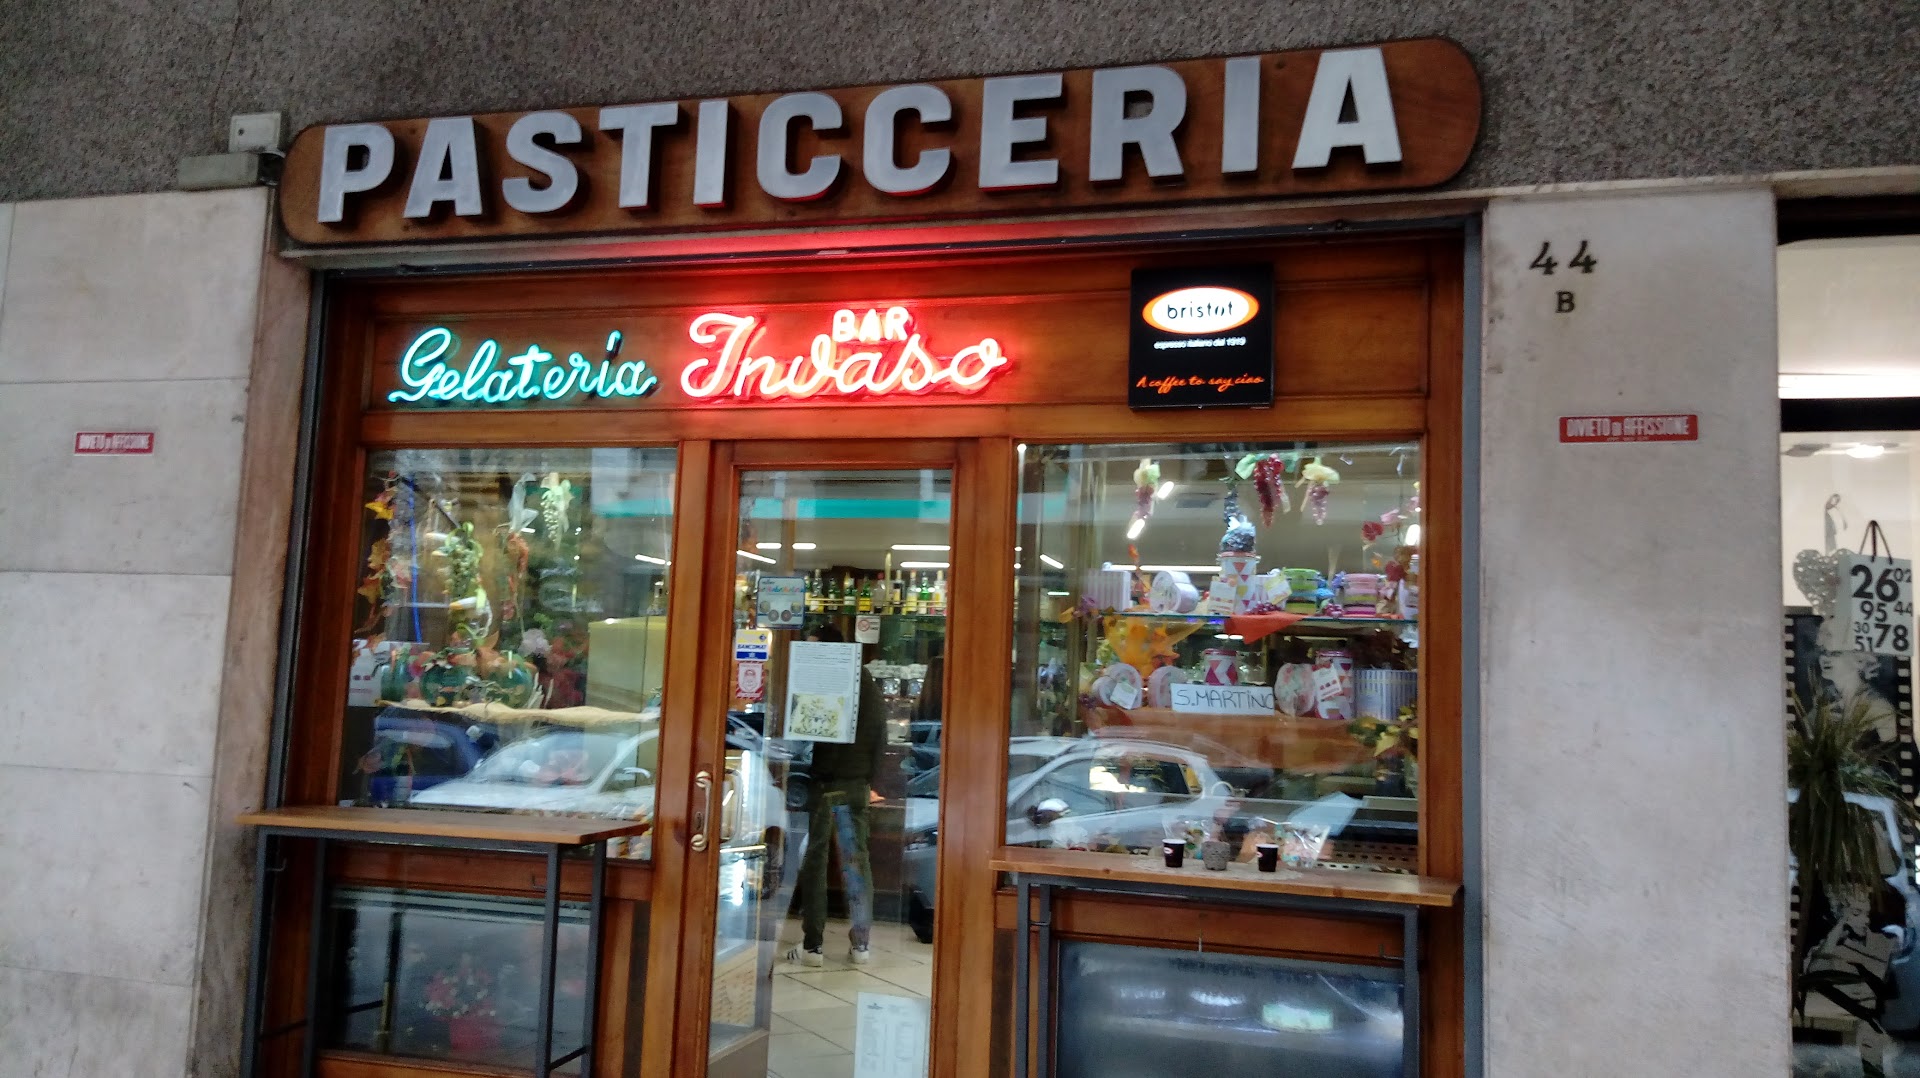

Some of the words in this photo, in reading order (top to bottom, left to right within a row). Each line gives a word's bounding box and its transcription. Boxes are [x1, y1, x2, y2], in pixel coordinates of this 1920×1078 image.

[316, 46, 1402, 224] PASTICCERIA
[1529, 239, 1598, 276] 44
[1166, 301, 1234, 320] bristot
[1555, 290, 1576, 314] B
[831, 305, 910, 343] BAR
[388, 326, 658, 404] Gelateria
[679, 312, 1008, 398] Invaso
[1136, 375, 1148, 388] A
[1149, 376, 1187, 395] coffee
[1188, 375, 1206, 387] to
[1208, 376, 1235, 393] say
[1234, 372, 1265, 385] ciao
[1850, 564, 1900, 603] 26
[1860, 600, 1888, 622] 95
[1874, 623, 1910, 652] 78
